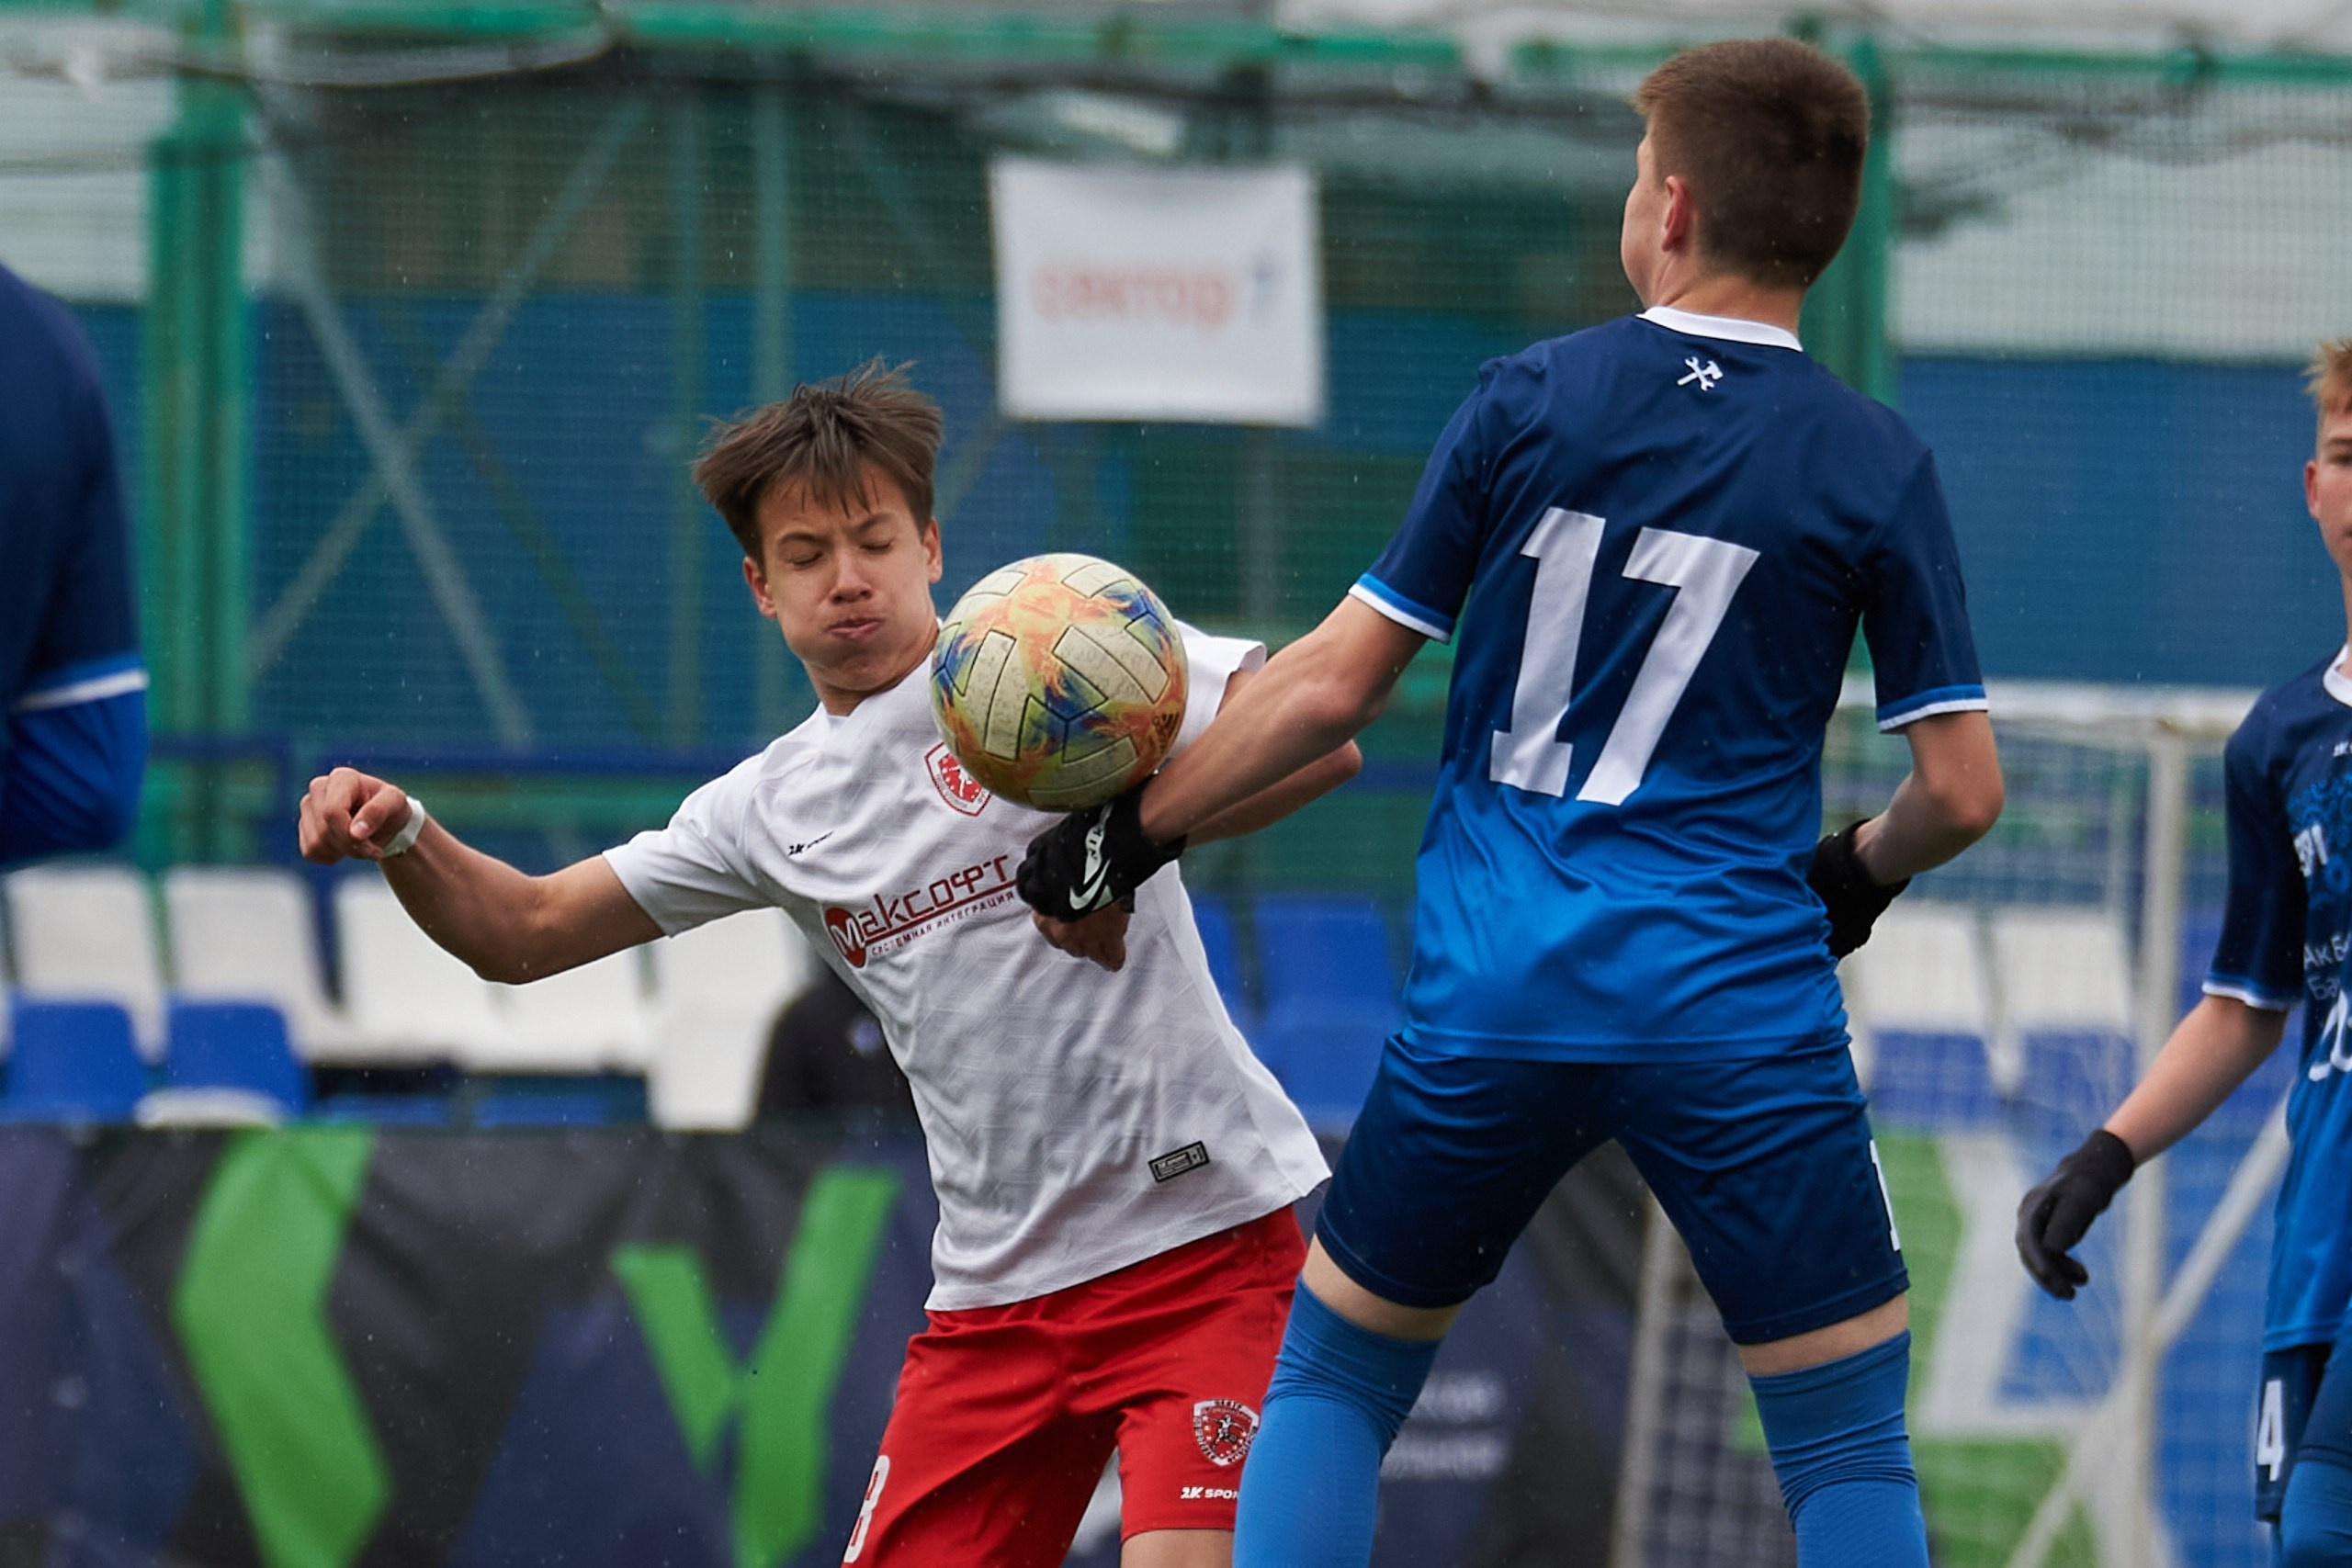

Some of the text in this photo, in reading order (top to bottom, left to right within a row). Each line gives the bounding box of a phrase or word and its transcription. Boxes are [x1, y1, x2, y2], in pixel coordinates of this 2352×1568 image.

[1489, 506, 1760, 806] 17
[871, 889, 1015, 956] СИСТЕМНАЯ ИНТЕГРАЦИЯ
[2256, 1379, 2285, 1482] 4
[1204, 1488, 1239, 1500] SPO
